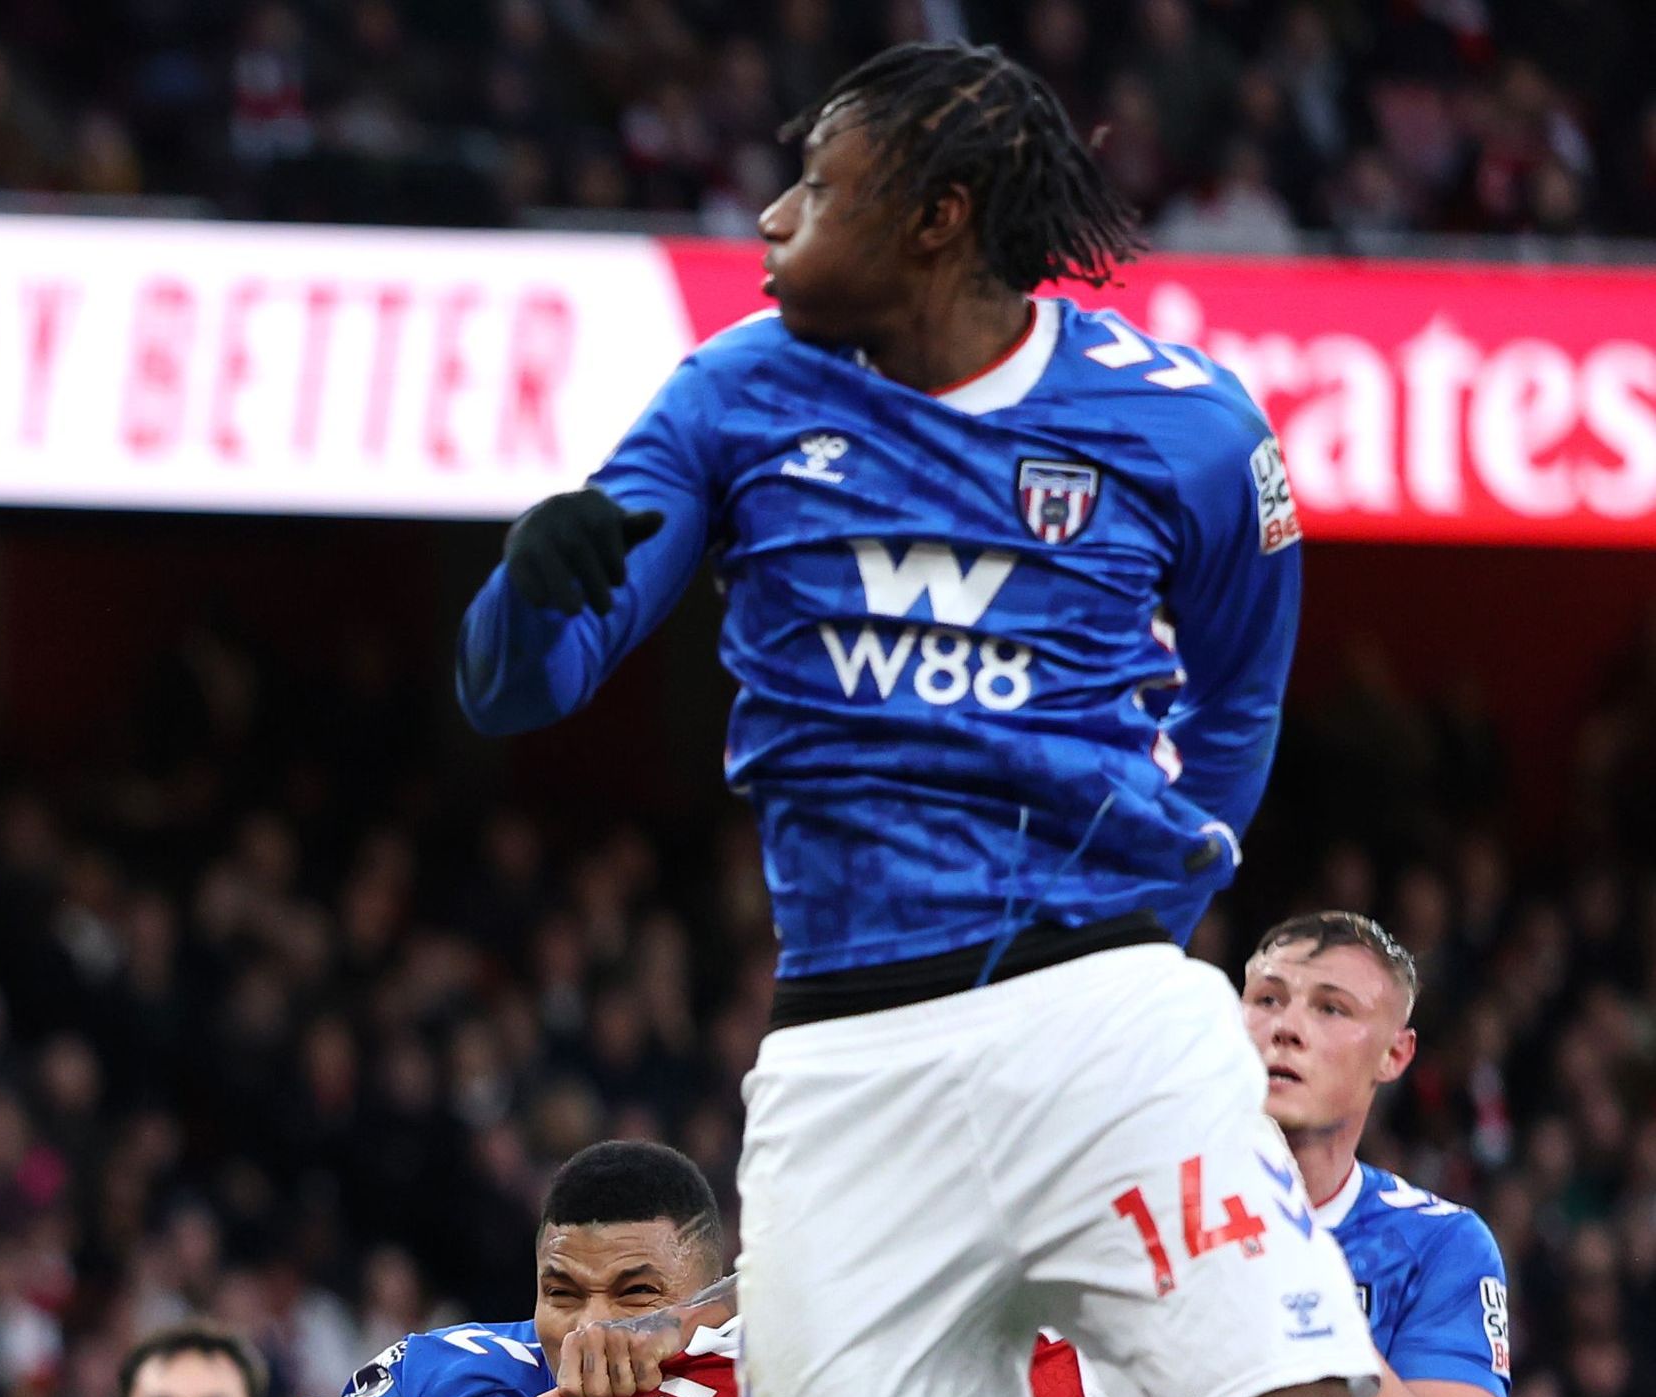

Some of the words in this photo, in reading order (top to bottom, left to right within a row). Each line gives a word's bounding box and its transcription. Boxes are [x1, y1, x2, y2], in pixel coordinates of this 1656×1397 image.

[117, 272, 579, 472] BETTER
[818, 620, 1035, 714] W88
[1112, 1157, 1268, 1298] 14
